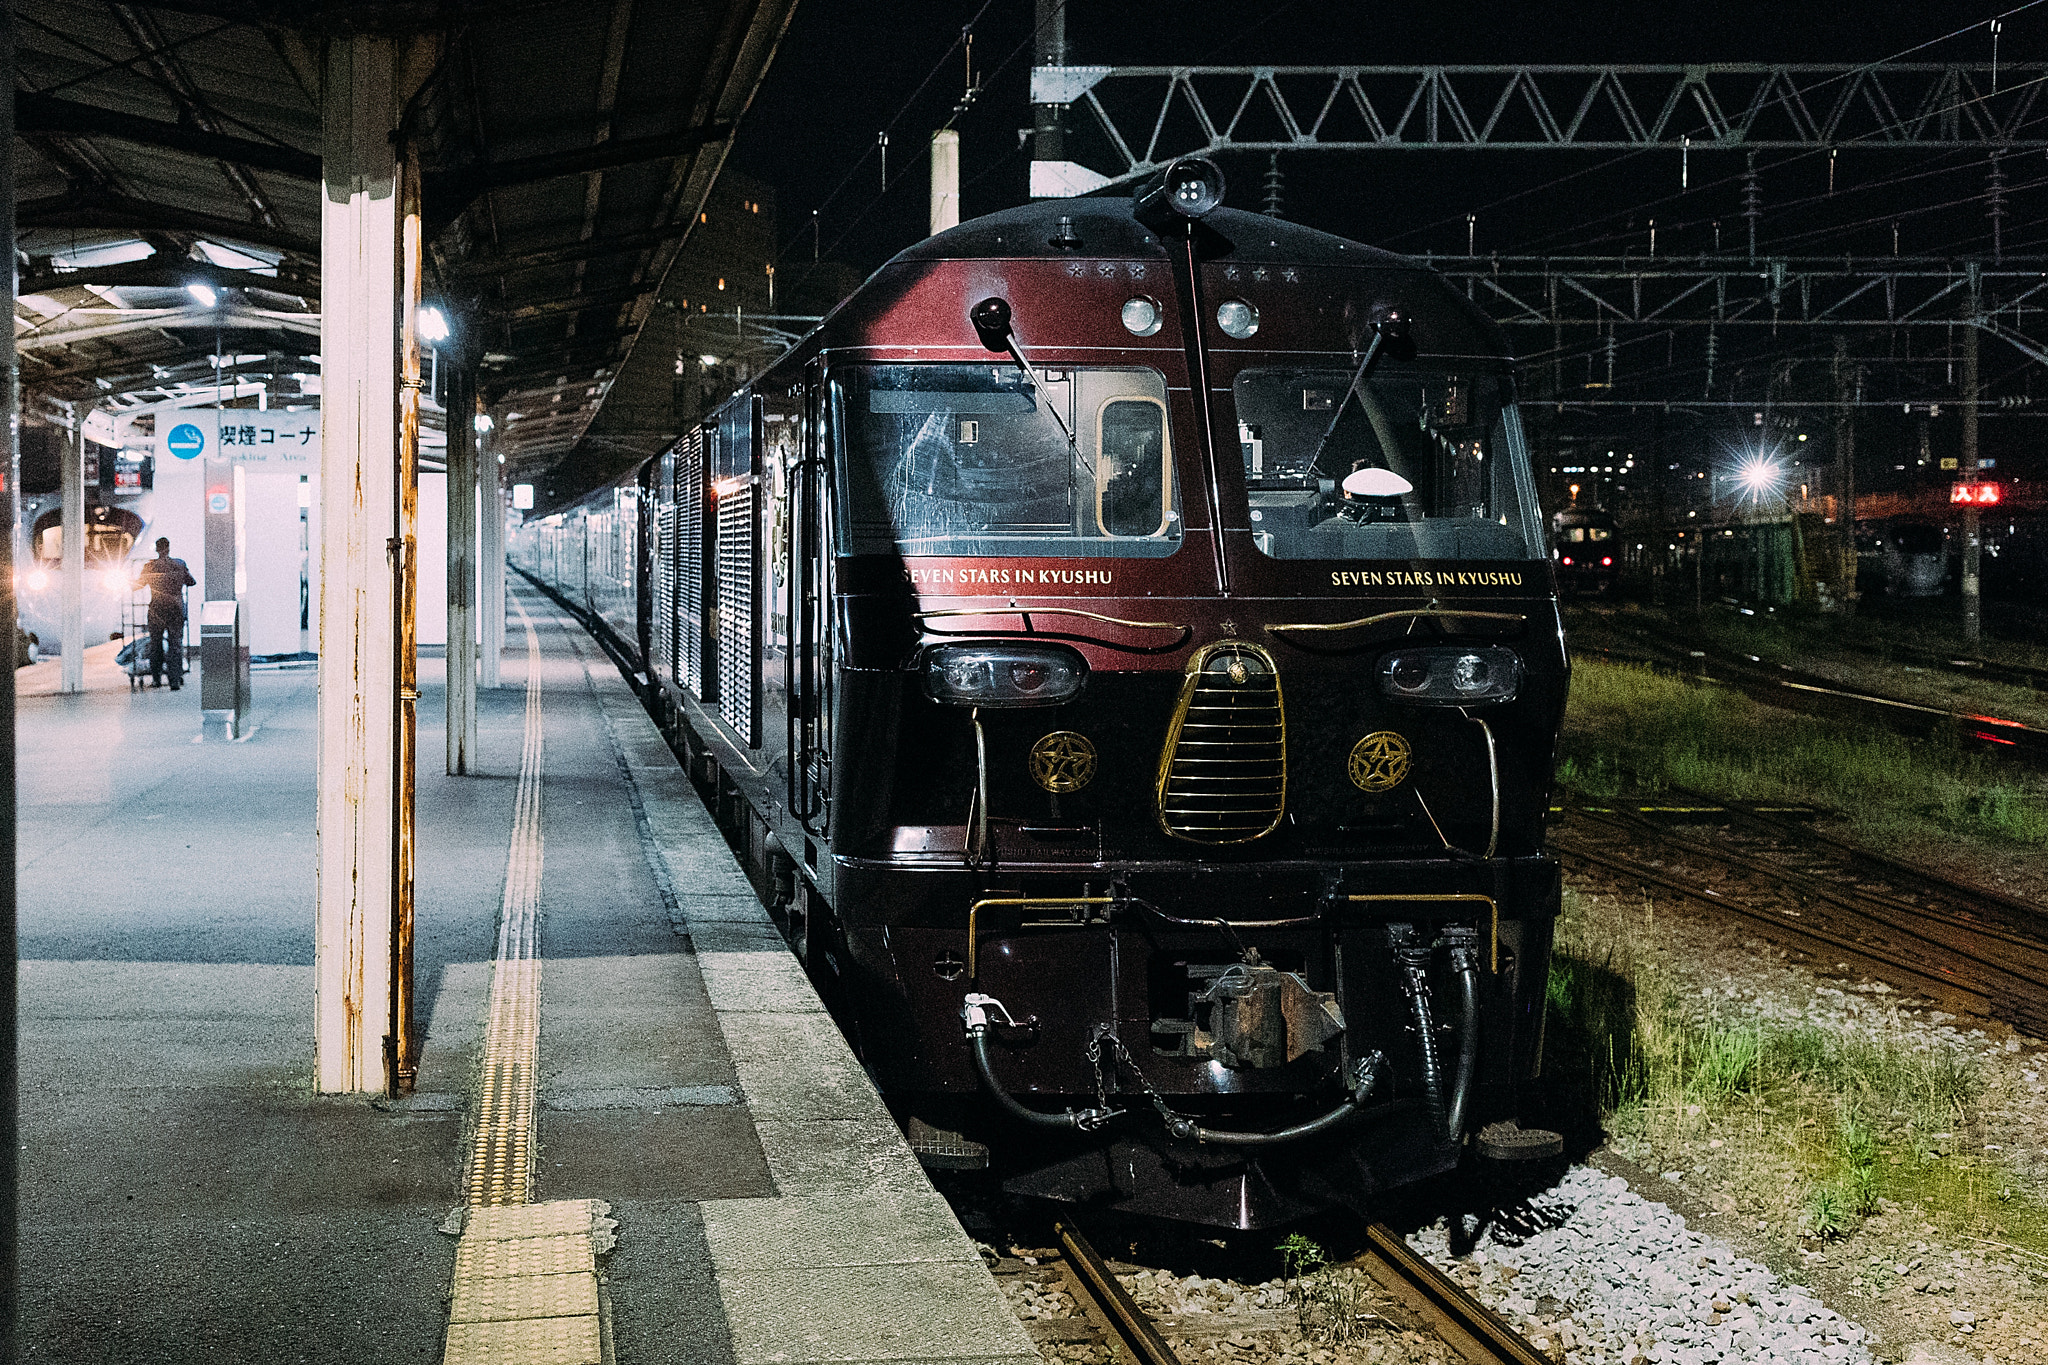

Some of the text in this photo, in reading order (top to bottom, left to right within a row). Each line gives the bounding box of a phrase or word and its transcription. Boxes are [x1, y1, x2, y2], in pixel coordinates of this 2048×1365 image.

[220, 425, 316, 446] 喫煙コーナ
[902, 569, 1113, 585] SEVEN STARS IN KYUSHU
[1331, 571, 1523, 586] SEVEN STARS IN KYUSHU
